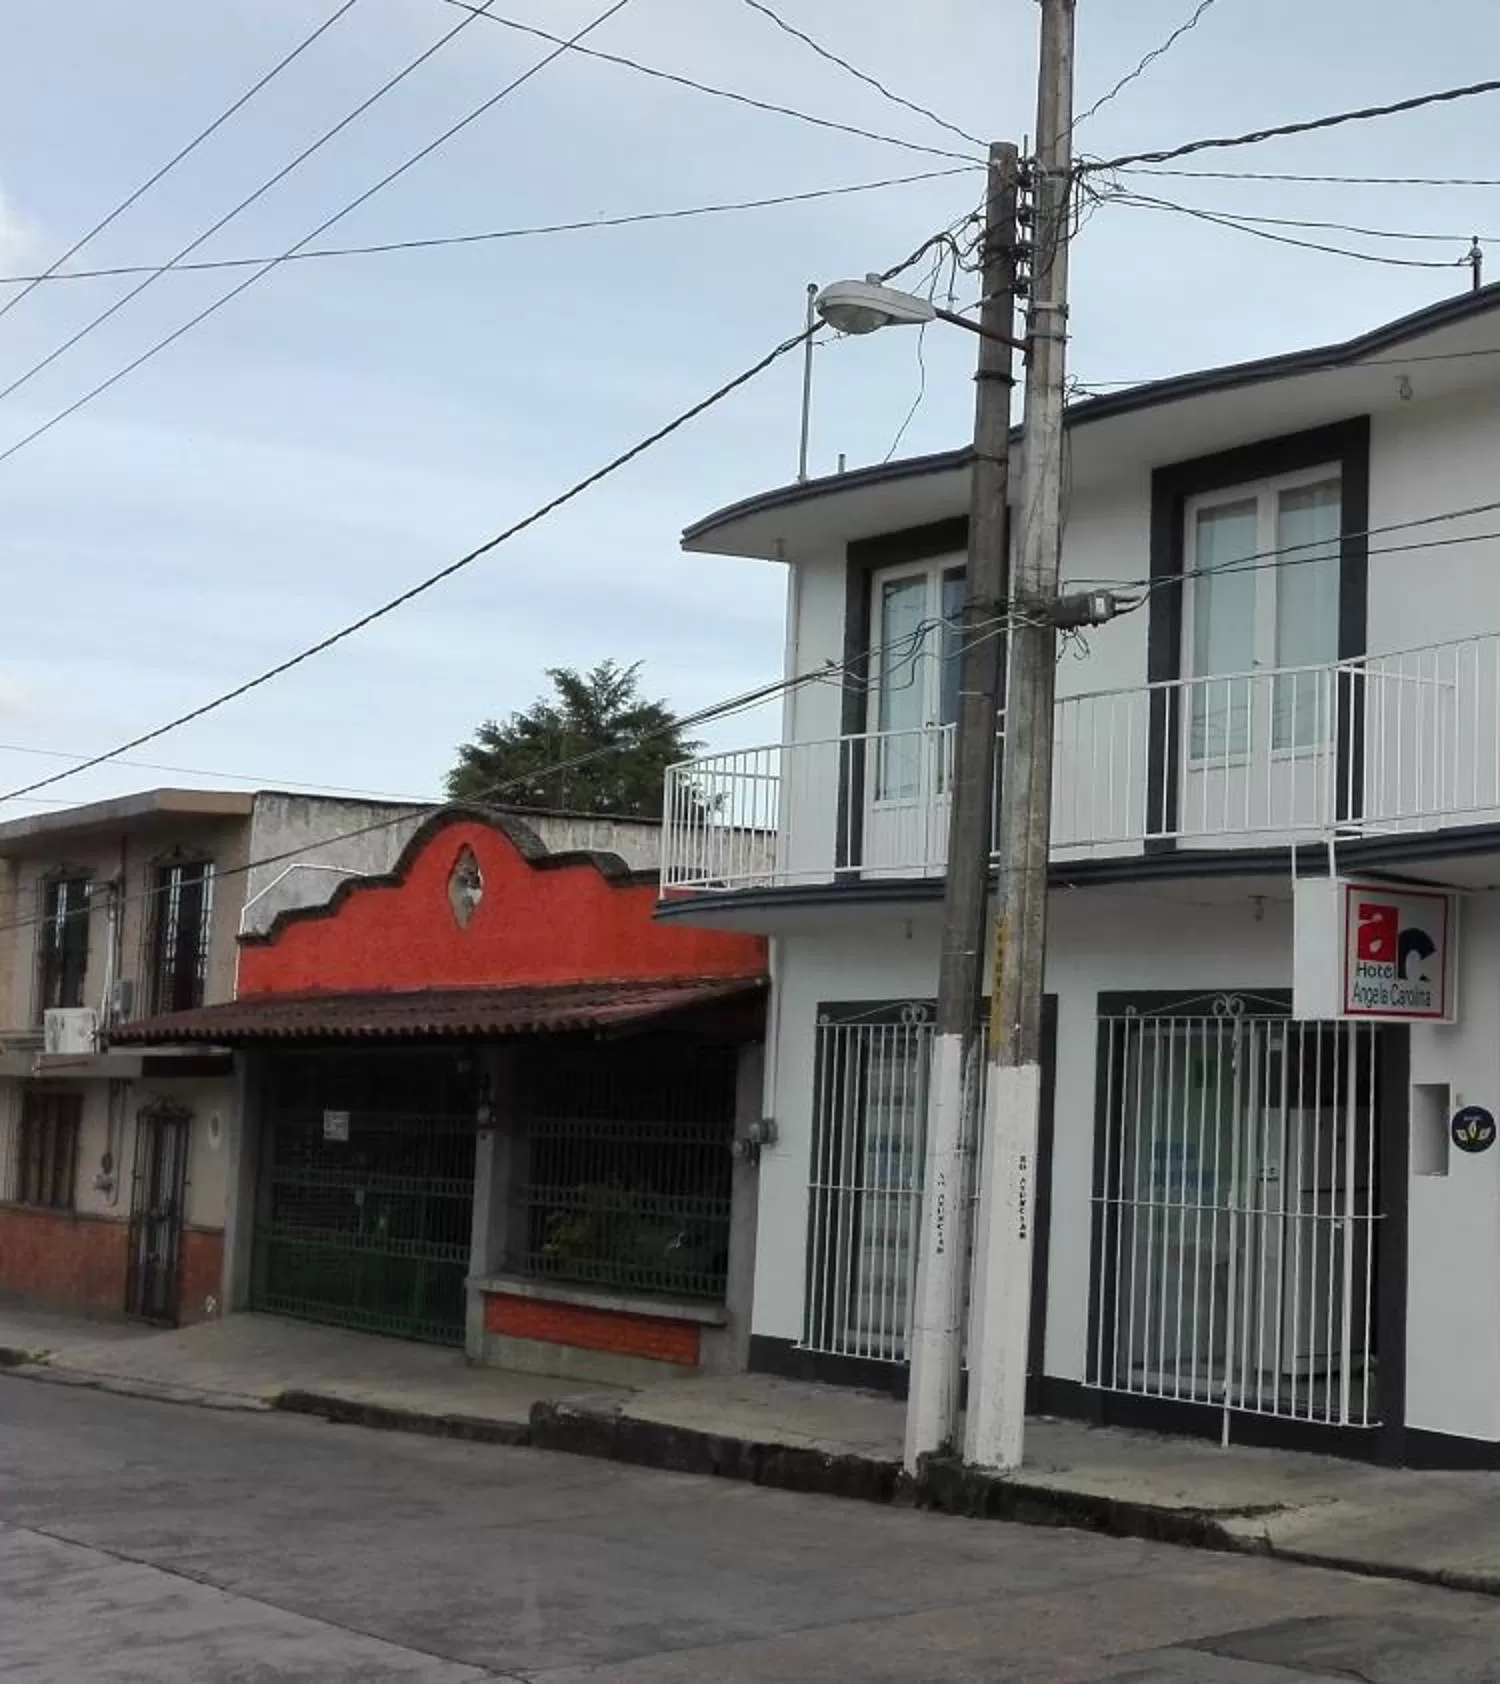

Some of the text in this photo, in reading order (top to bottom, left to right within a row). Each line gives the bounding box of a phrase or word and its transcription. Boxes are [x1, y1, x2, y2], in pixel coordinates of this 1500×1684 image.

[1356, 963, 1398, 979] Hotel
[1353, 983, 1431, 1007] Angela Carolina
